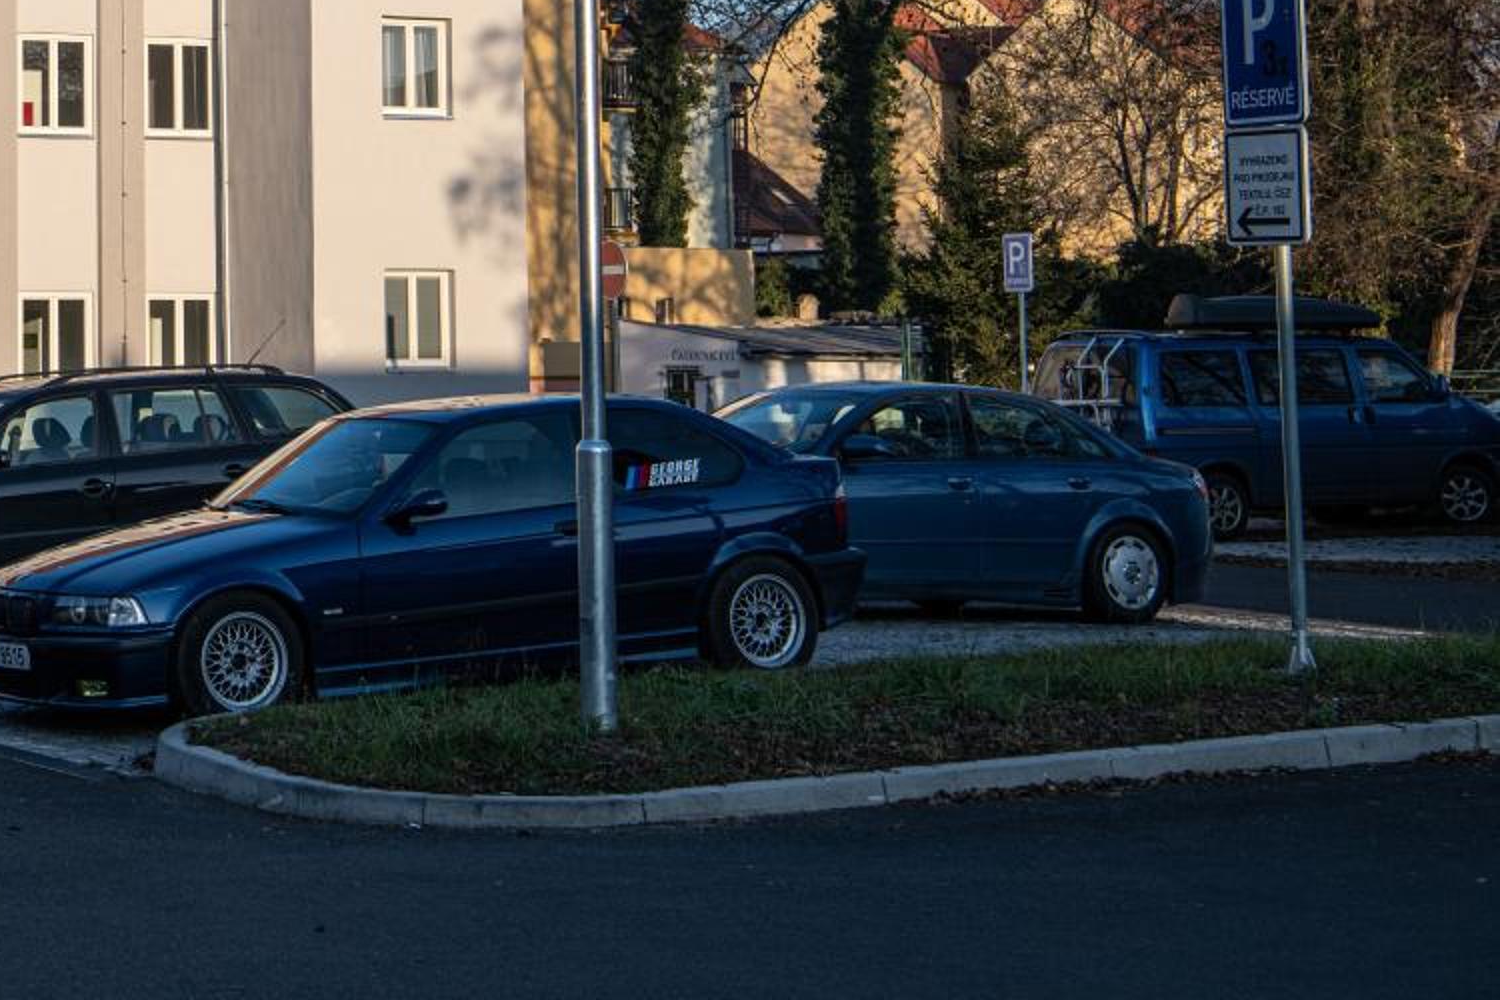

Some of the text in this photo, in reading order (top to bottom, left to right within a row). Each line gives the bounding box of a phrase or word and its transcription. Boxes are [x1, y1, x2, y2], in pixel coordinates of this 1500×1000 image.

[1009, 241, 1025, 275] P
[651, 457, 700, 475] GEORGE
[648, 472, 698, 487] GARAGE
